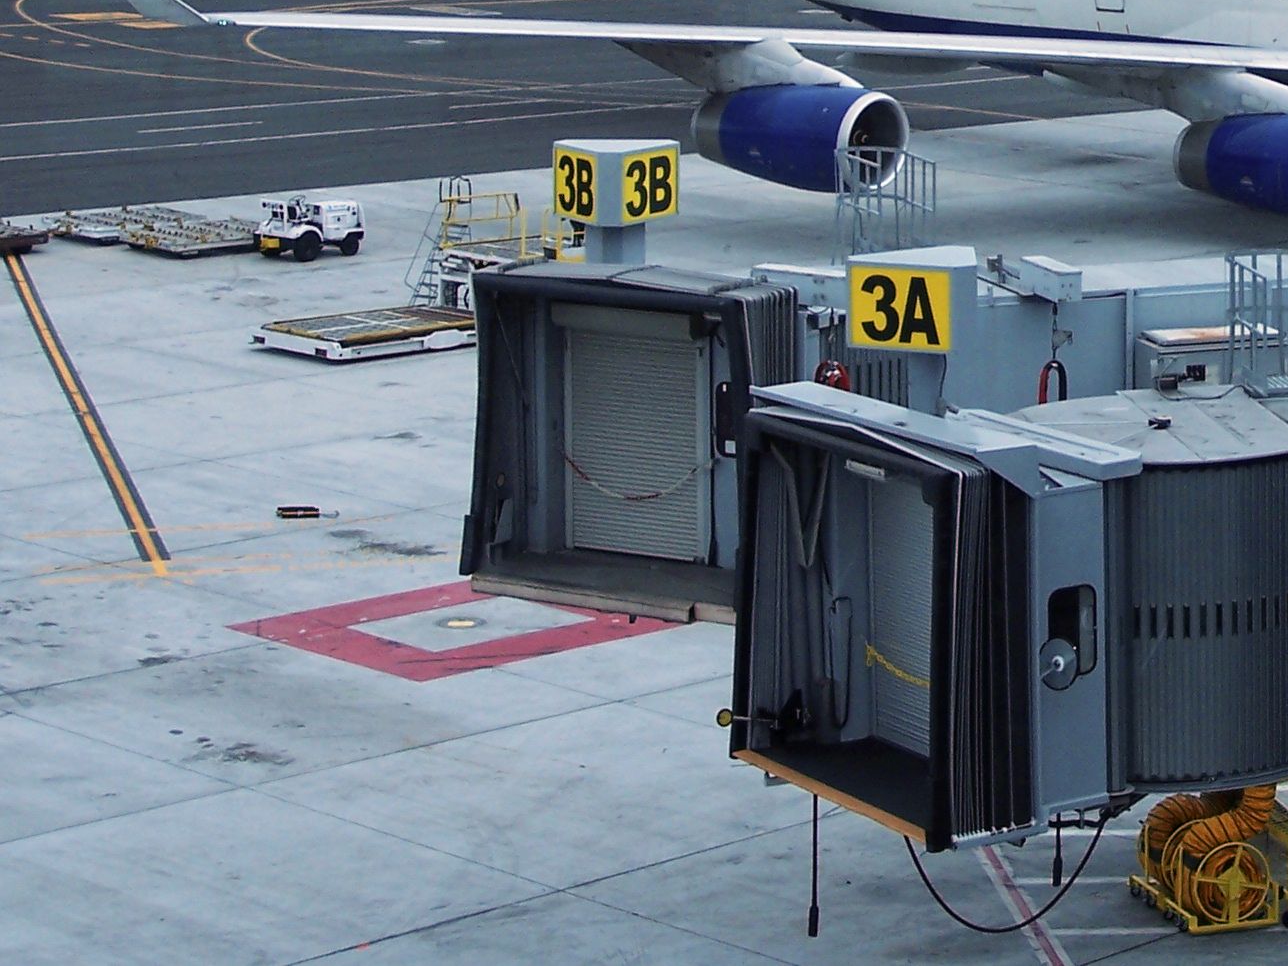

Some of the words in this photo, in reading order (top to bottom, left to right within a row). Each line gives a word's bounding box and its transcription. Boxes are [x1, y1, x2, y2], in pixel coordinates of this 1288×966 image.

[558, 155, 594, 217] 3B
[626, 155, 672, 217] 3B
[861, 274, 941, 346] 3A
